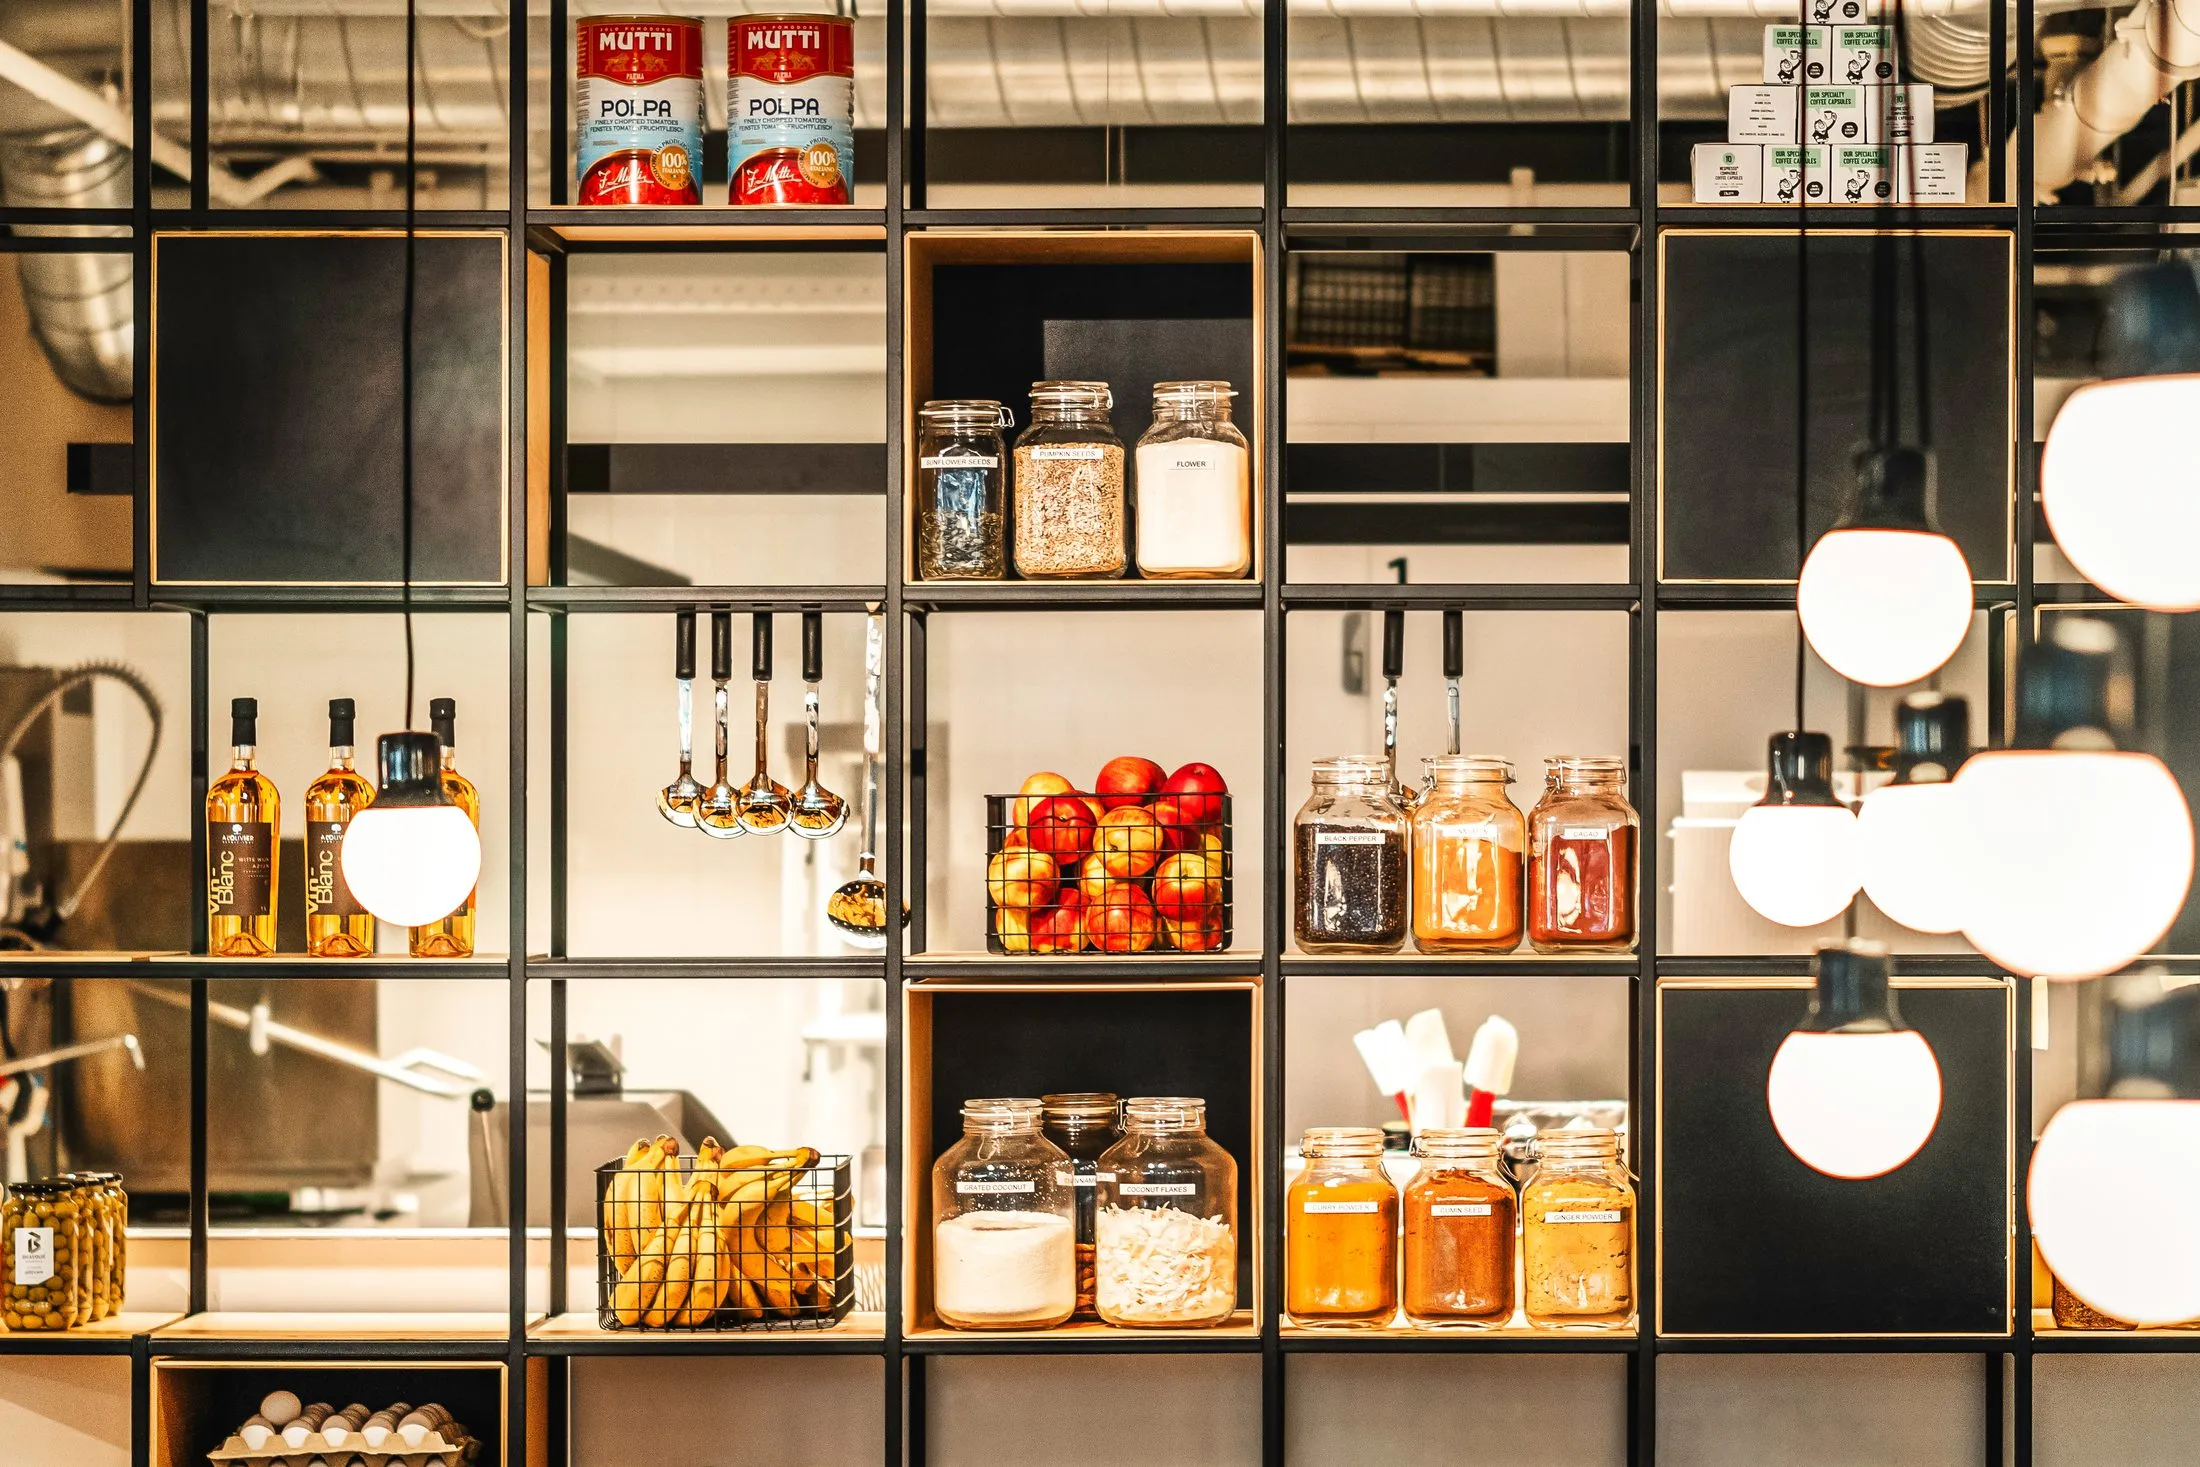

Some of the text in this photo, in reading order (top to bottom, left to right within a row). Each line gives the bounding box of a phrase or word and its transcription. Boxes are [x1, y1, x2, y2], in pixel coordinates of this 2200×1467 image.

[599, 32, 673, 51] MUTTI
[747, 30, 820, 50] MUTTI
[601, 99, 672, 118] POLPA
[750, 98, 820, 116] POLPA
[662, 152, 688, 168] 100%
[809, 150, 836, 166] 100%
[218, 850, 234, 905] Blanc
[316, 850, 334, 904] Blanc
